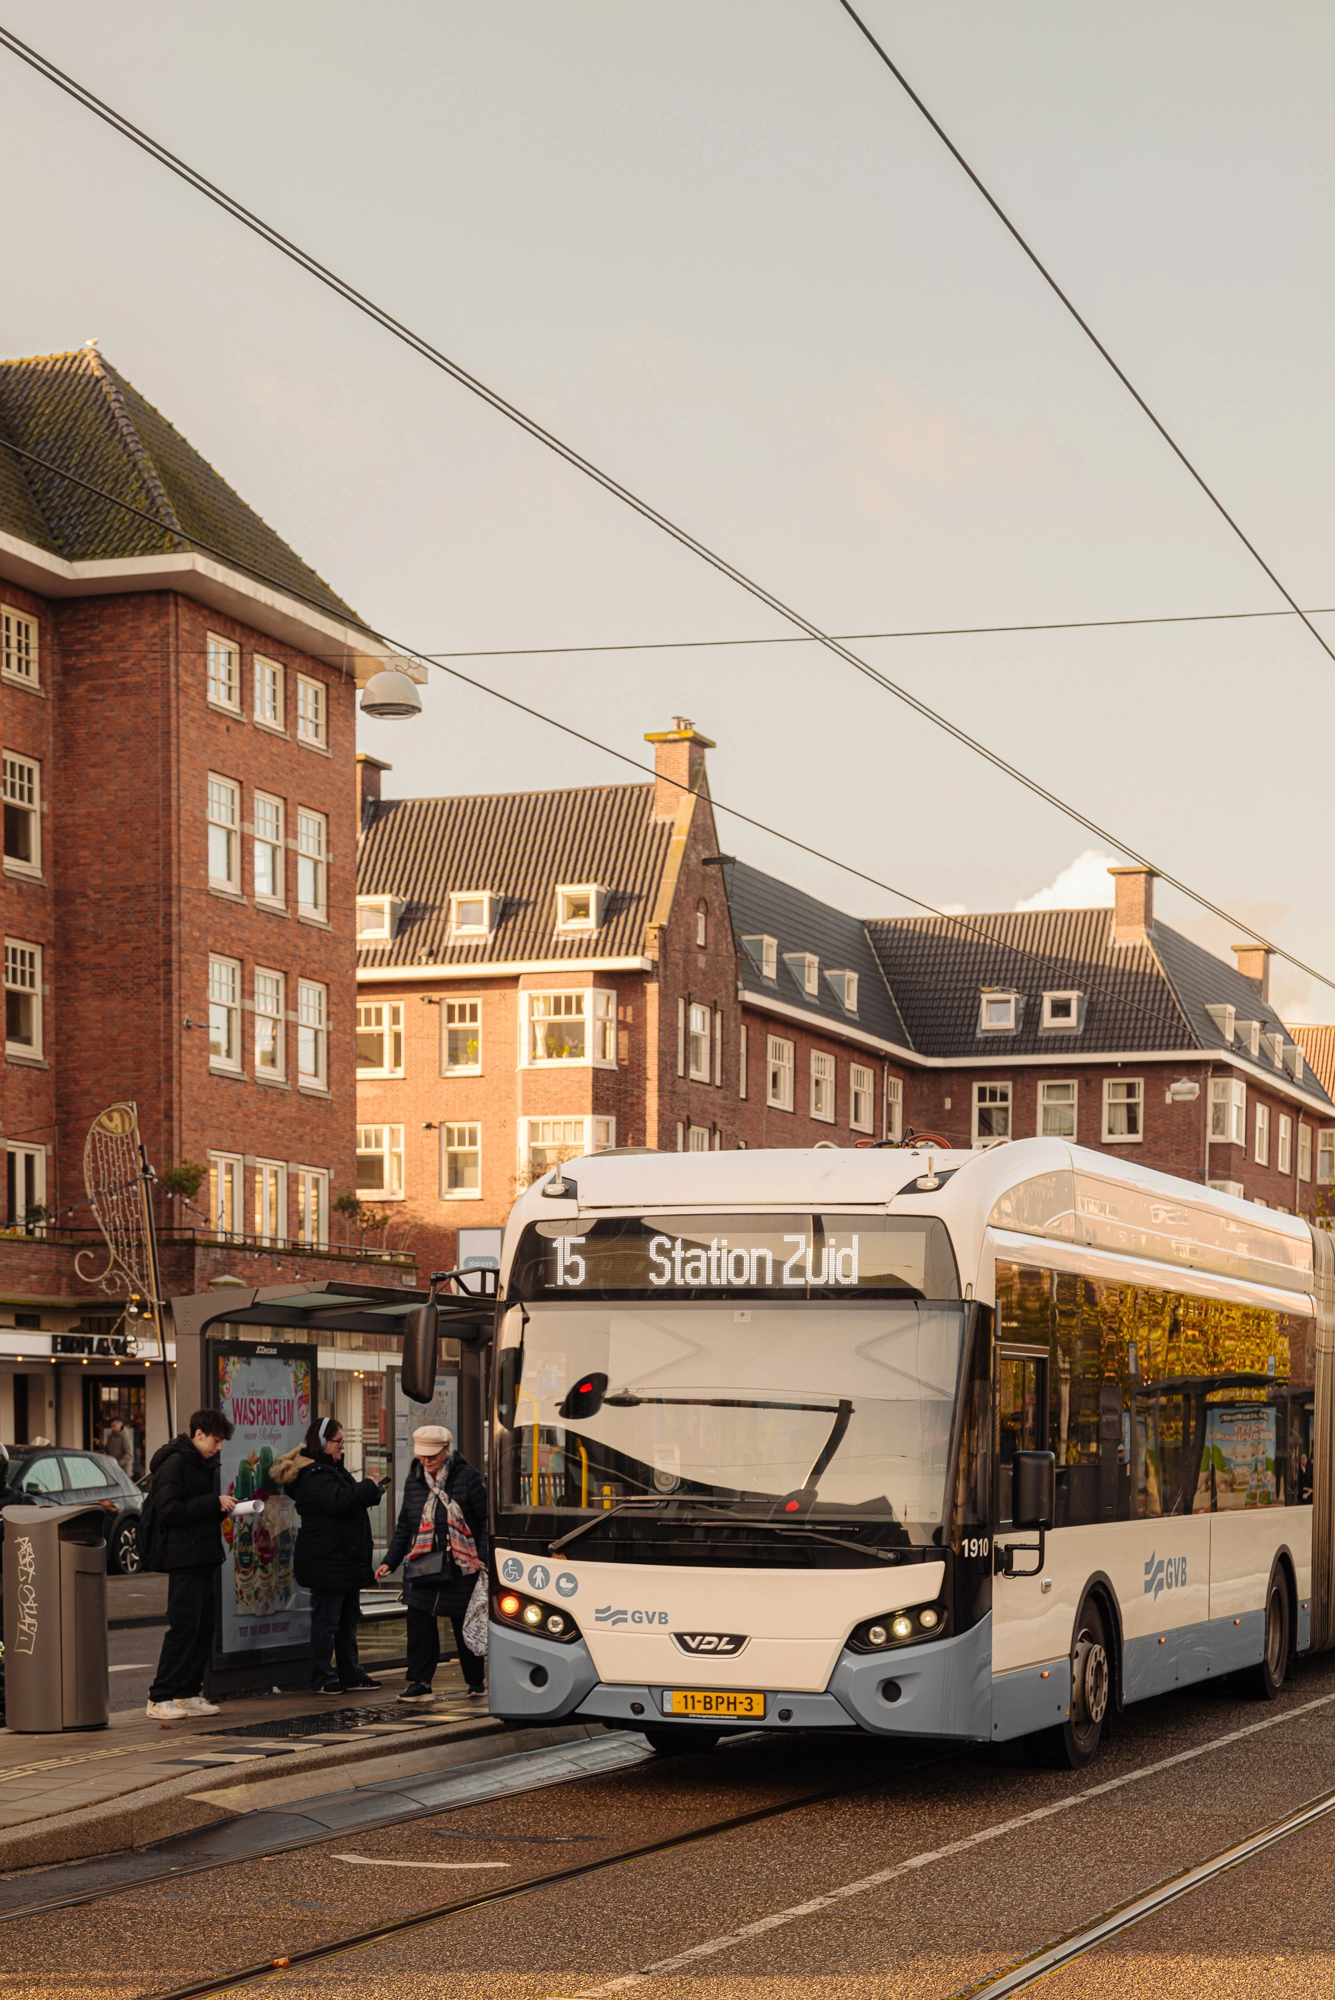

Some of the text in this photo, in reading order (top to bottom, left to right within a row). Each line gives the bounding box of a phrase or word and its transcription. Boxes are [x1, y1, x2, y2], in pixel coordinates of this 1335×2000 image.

[553, 1235, 859, 1285] 15 Station Zuid
[255, 1345, 278, 1355] JCDecaux
[231, 1398, 295, 1426] WASPARFUM
[244, 1426, 282, 1445] van Robijn
[961, 1537, 989, 1558] 1910
[1165, 1556, 1188, 1590] GVB
[631, 1610, 669, 1625] GVB
[683, 1635, 736, 1650] VDL
[683, 1694, 753, 1711] 11-BPH-3
